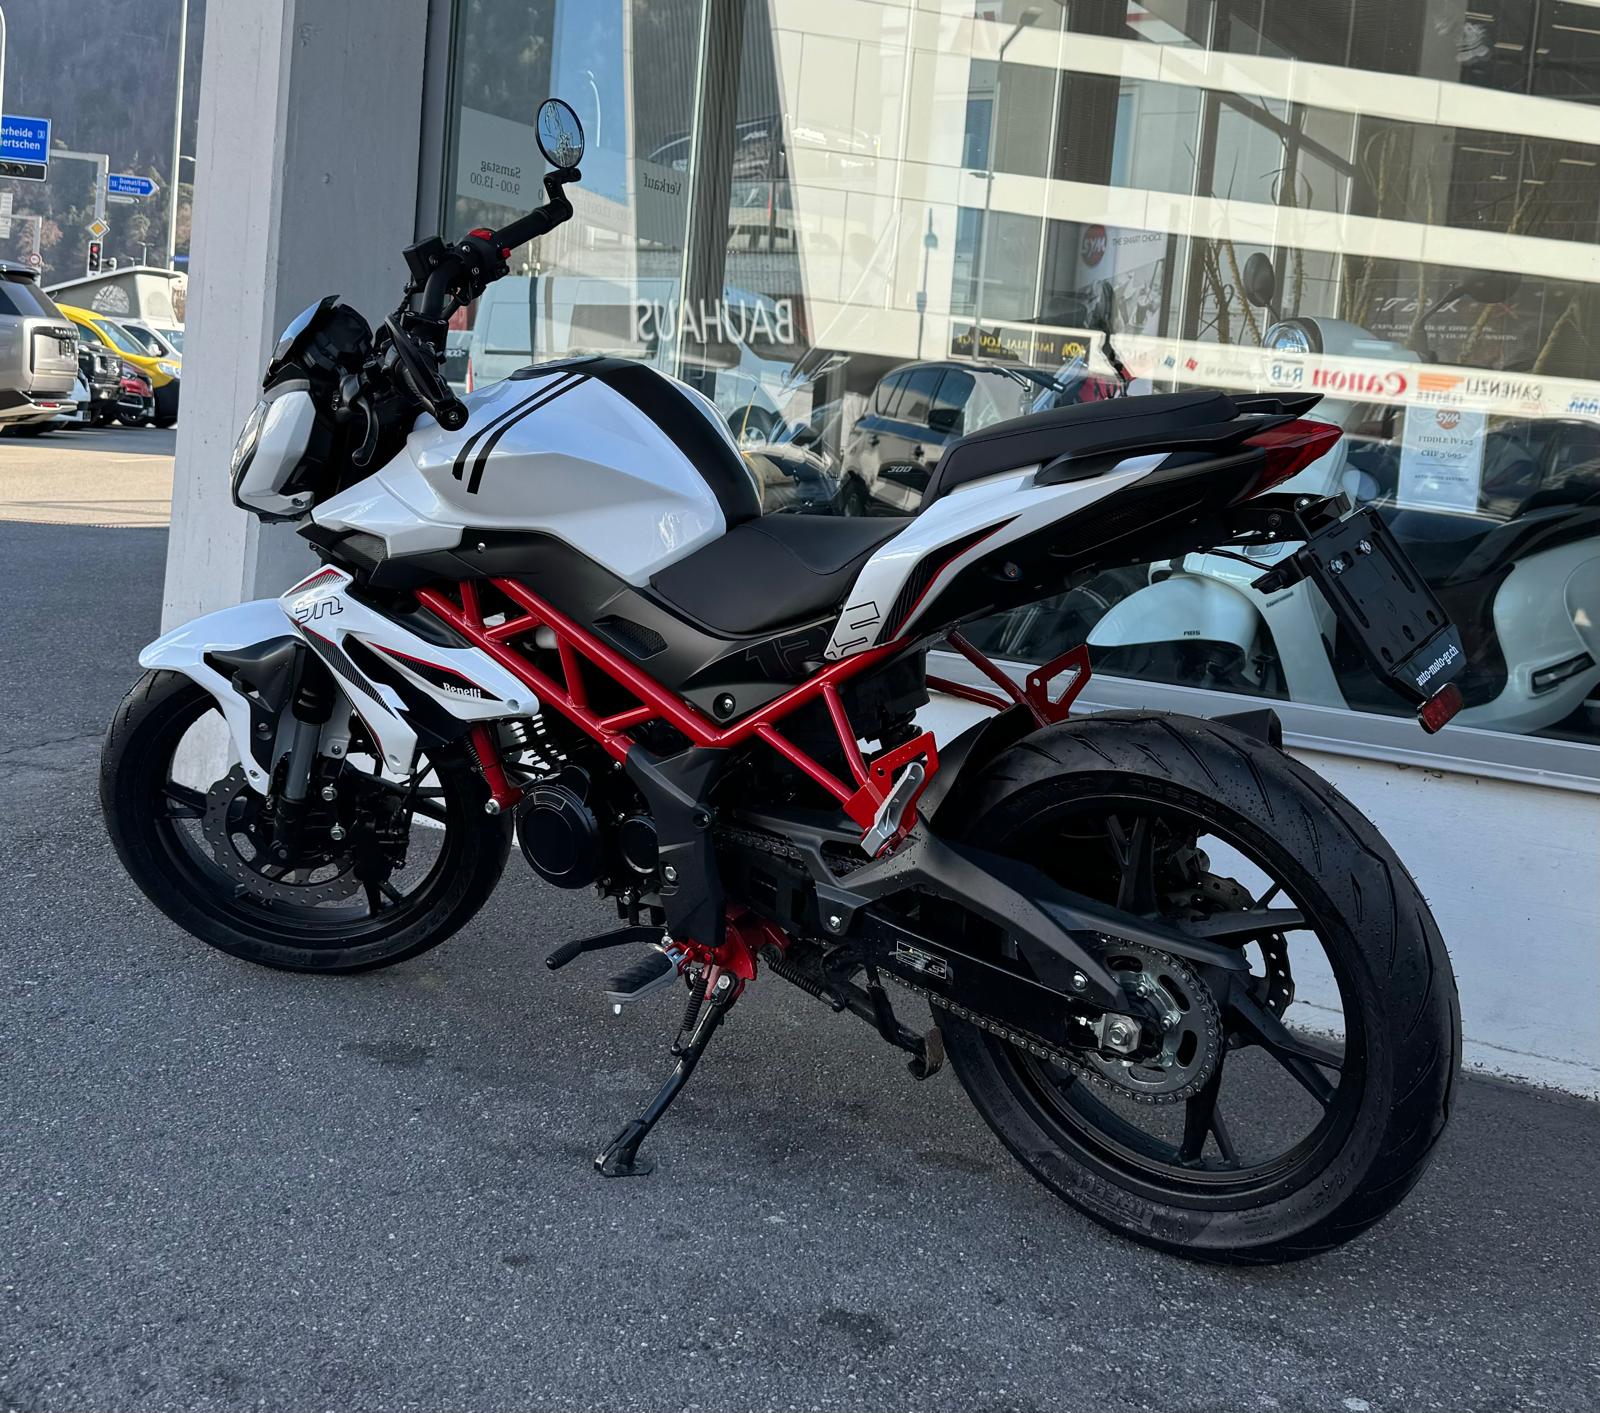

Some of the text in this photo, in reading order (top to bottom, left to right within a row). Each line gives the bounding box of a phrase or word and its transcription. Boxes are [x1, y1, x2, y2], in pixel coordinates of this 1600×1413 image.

[1082, 237, 1107, 256] SYM
[887, 465, 913, 473] 300
[1415, 643, 1460, 687] auto-moto-gr.ch
[442, 682, 482, 699] Benelli
